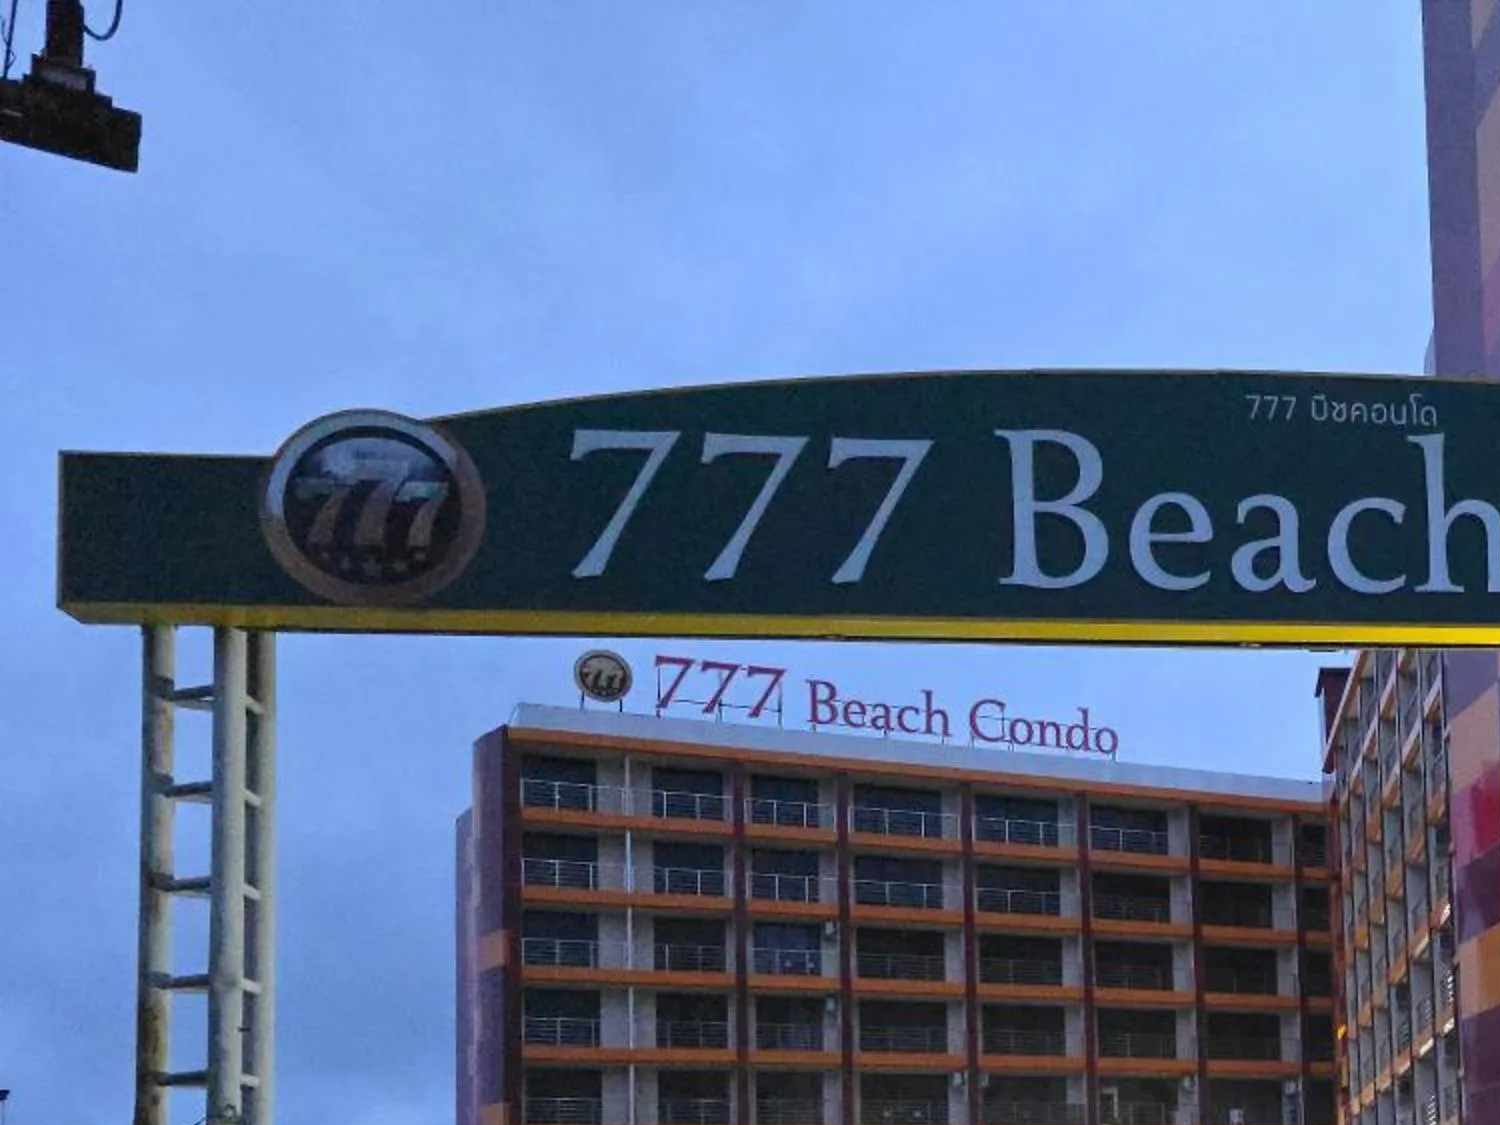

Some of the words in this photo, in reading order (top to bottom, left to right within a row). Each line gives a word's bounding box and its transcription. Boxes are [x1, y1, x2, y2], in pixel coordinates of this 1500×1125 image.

[1246, 394, 1296, 421] 777
[295, 467, 449, 548] 777
[570, 429, 935, 583] 777
[655, 655, 787, 718] 777
[805, 678, 953, 738] Beach
[969, 699, 1119, 754] Condo
